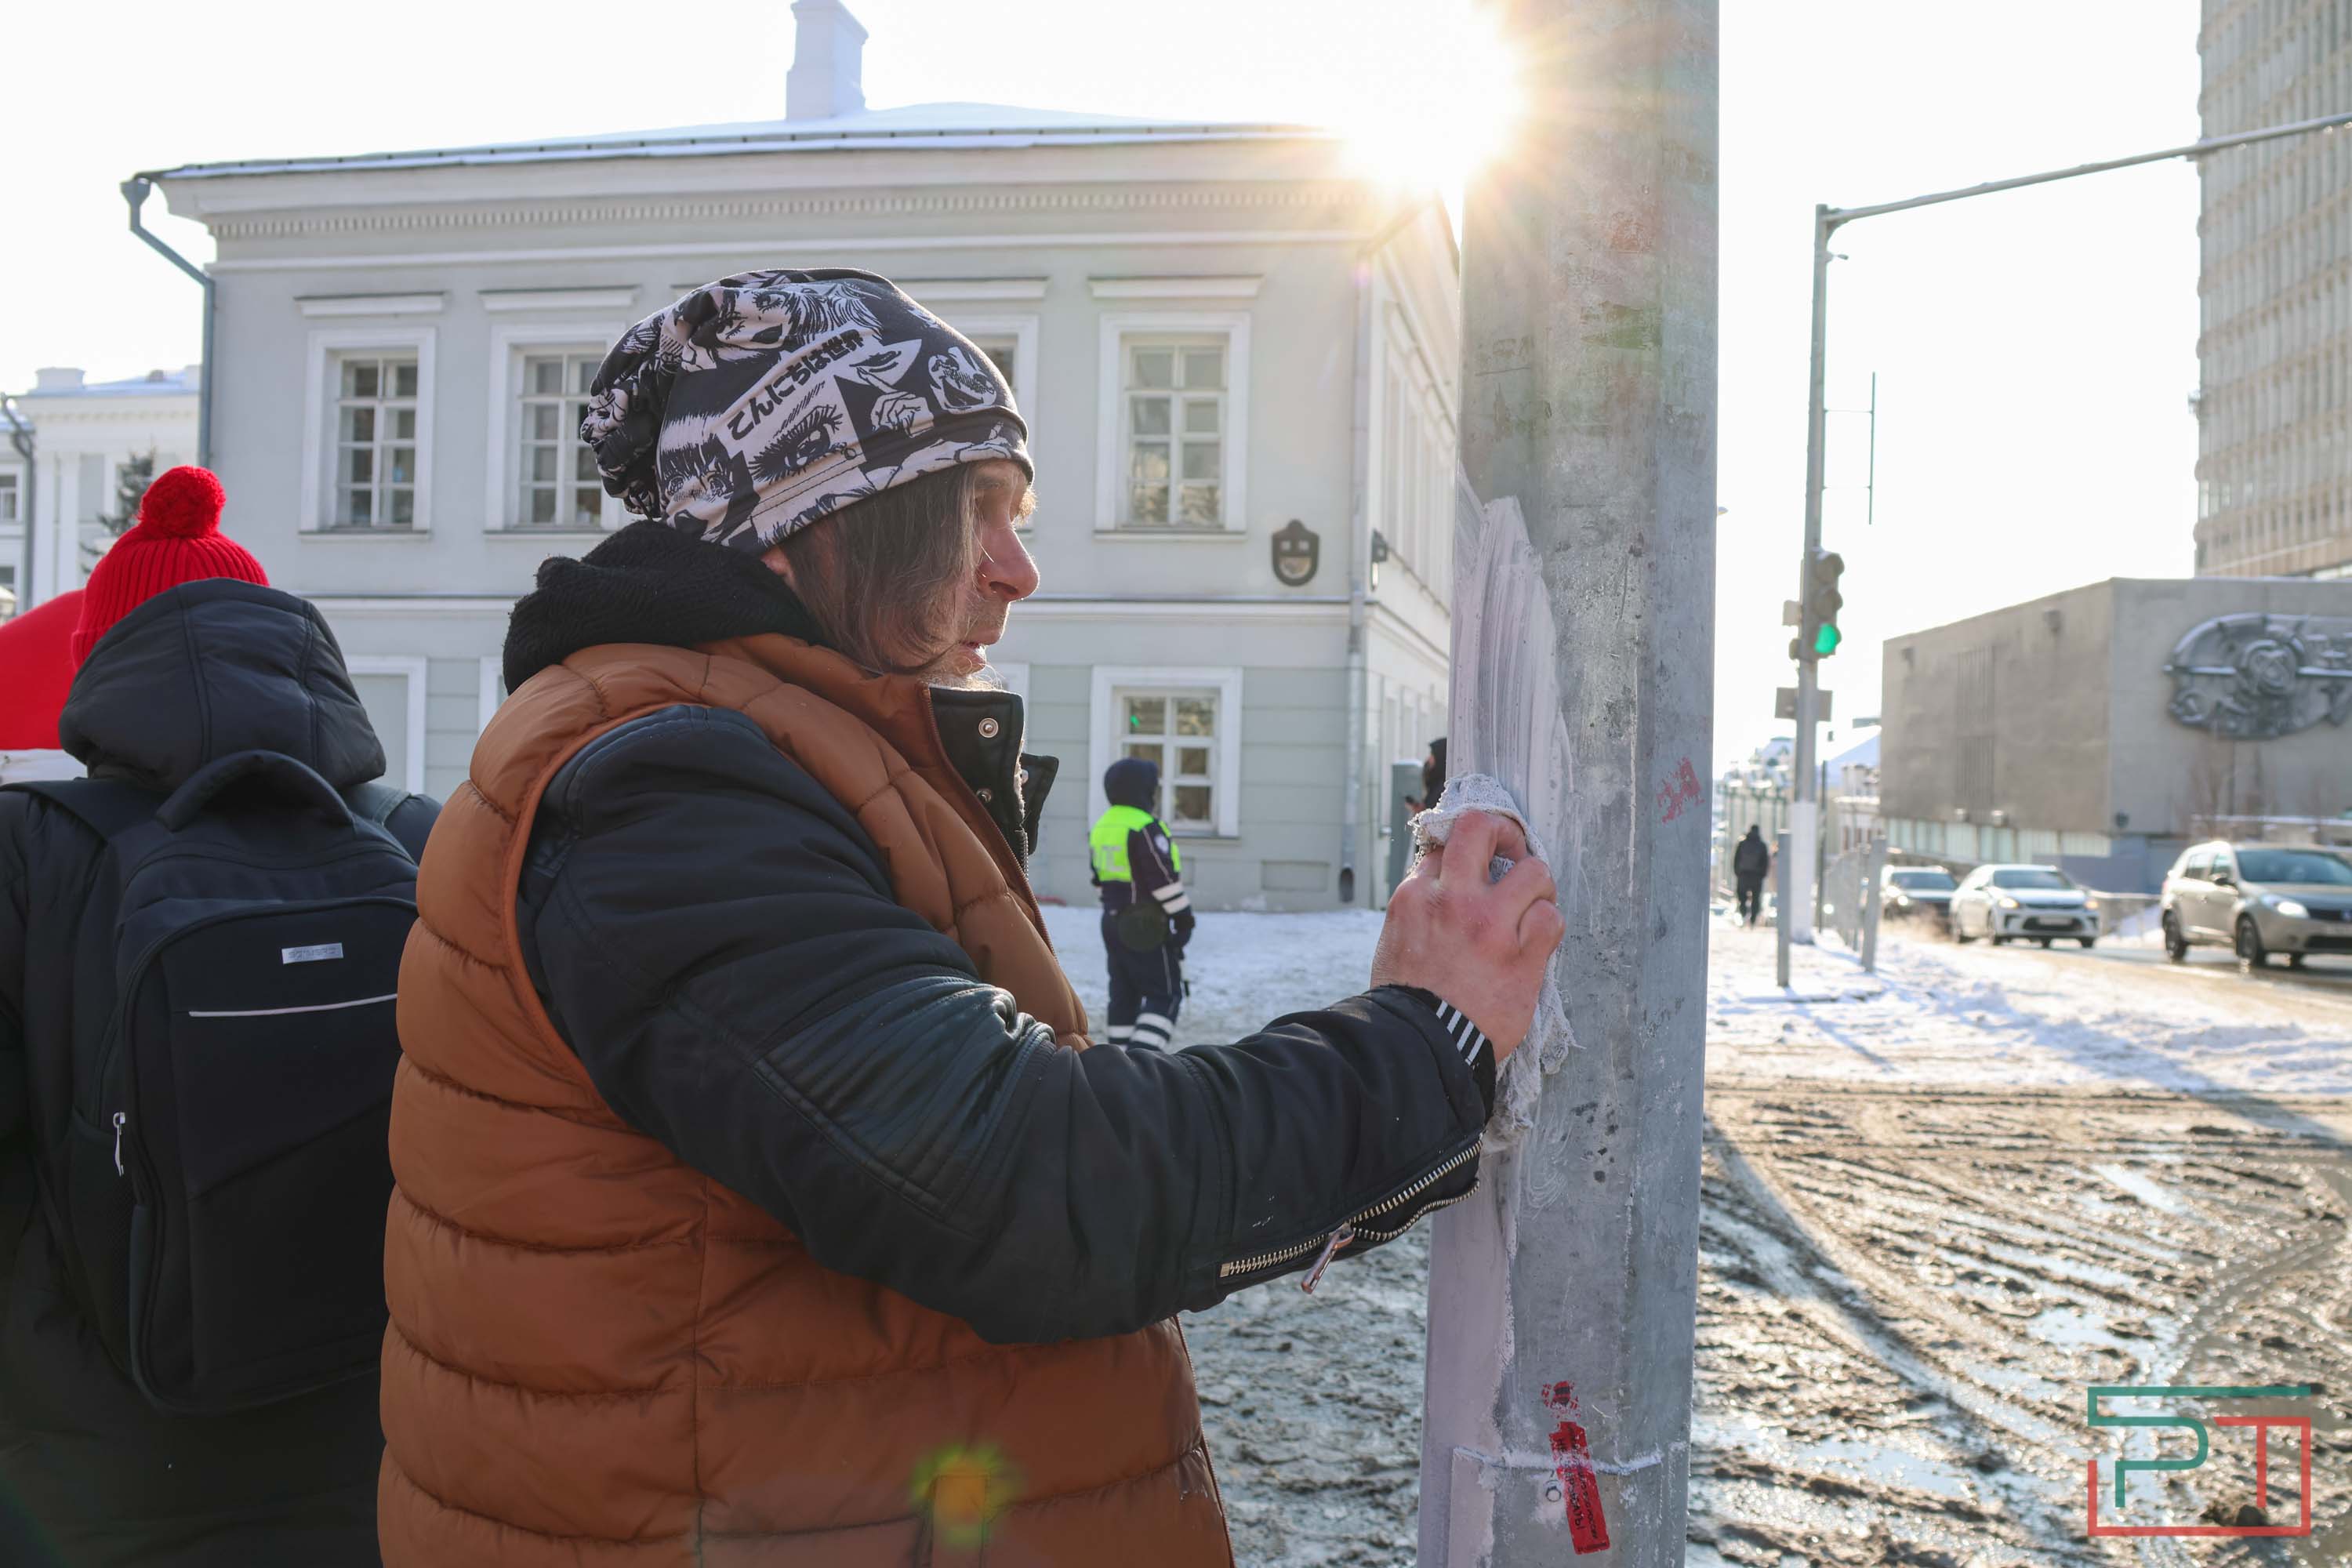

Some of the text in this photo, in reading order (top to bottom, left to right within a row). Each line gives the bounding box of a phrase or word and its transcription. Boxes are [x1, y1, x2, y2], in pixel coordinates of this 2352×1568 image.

[728, 328, 864, 441] こんにちは世界
